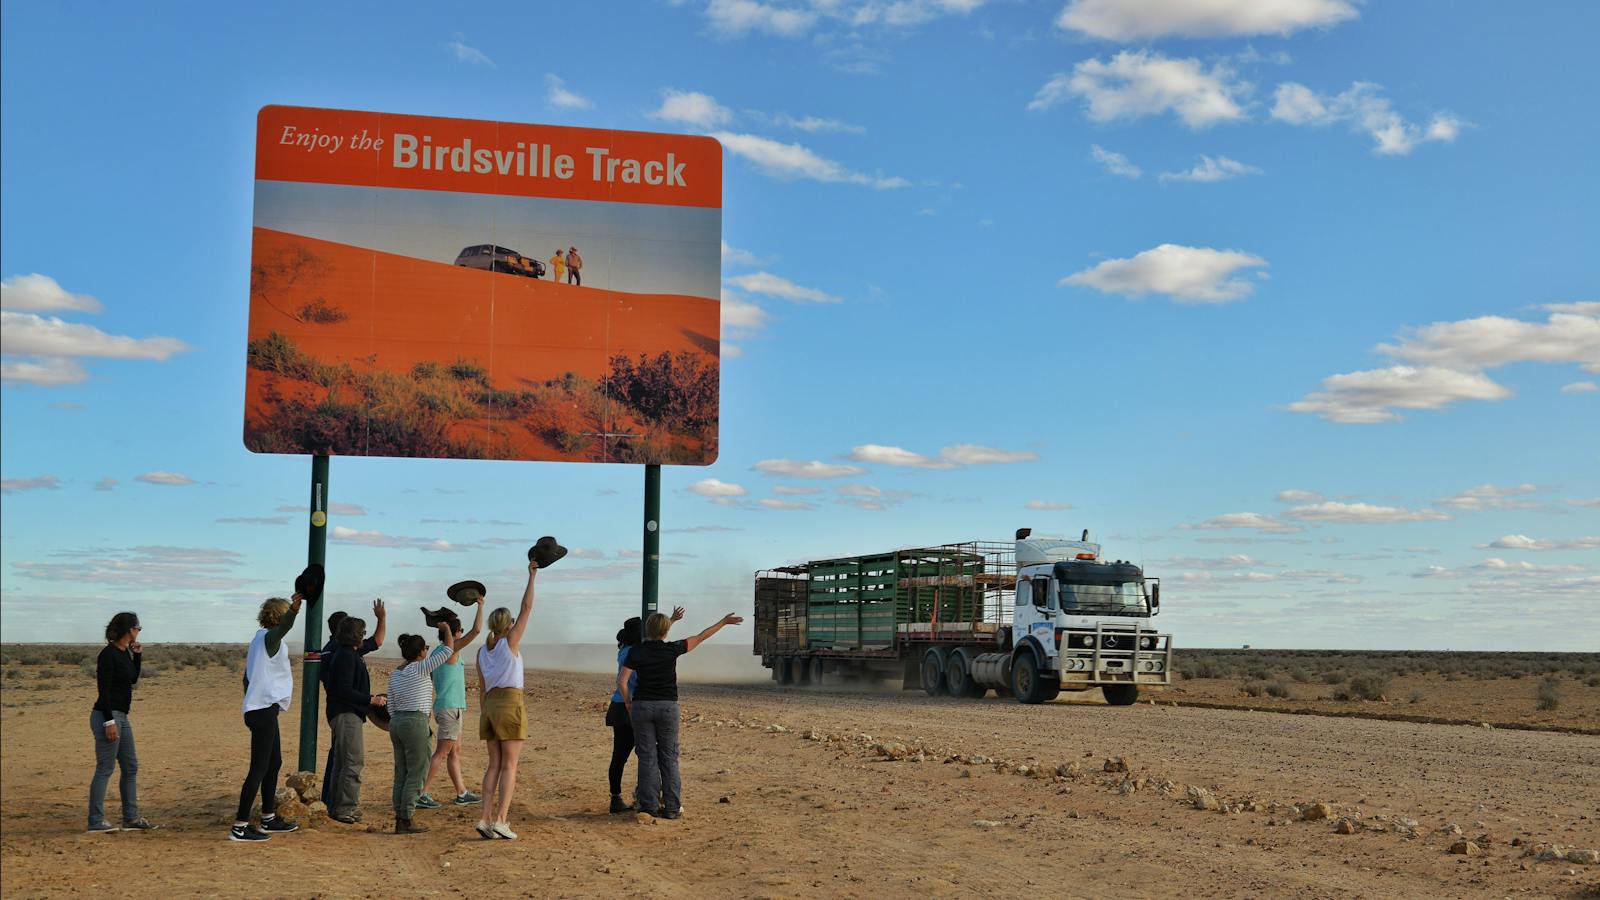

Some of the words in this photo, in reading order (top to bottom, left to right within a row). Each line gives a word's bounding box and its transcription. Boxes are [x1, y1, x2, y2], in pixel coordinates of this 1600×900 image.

[279, 126, 344, 153] Enjoy
[350, 130, 384, 151] the
[393, 133, 575, 180] Birdsville
[586, 147, 687, 187] Track
